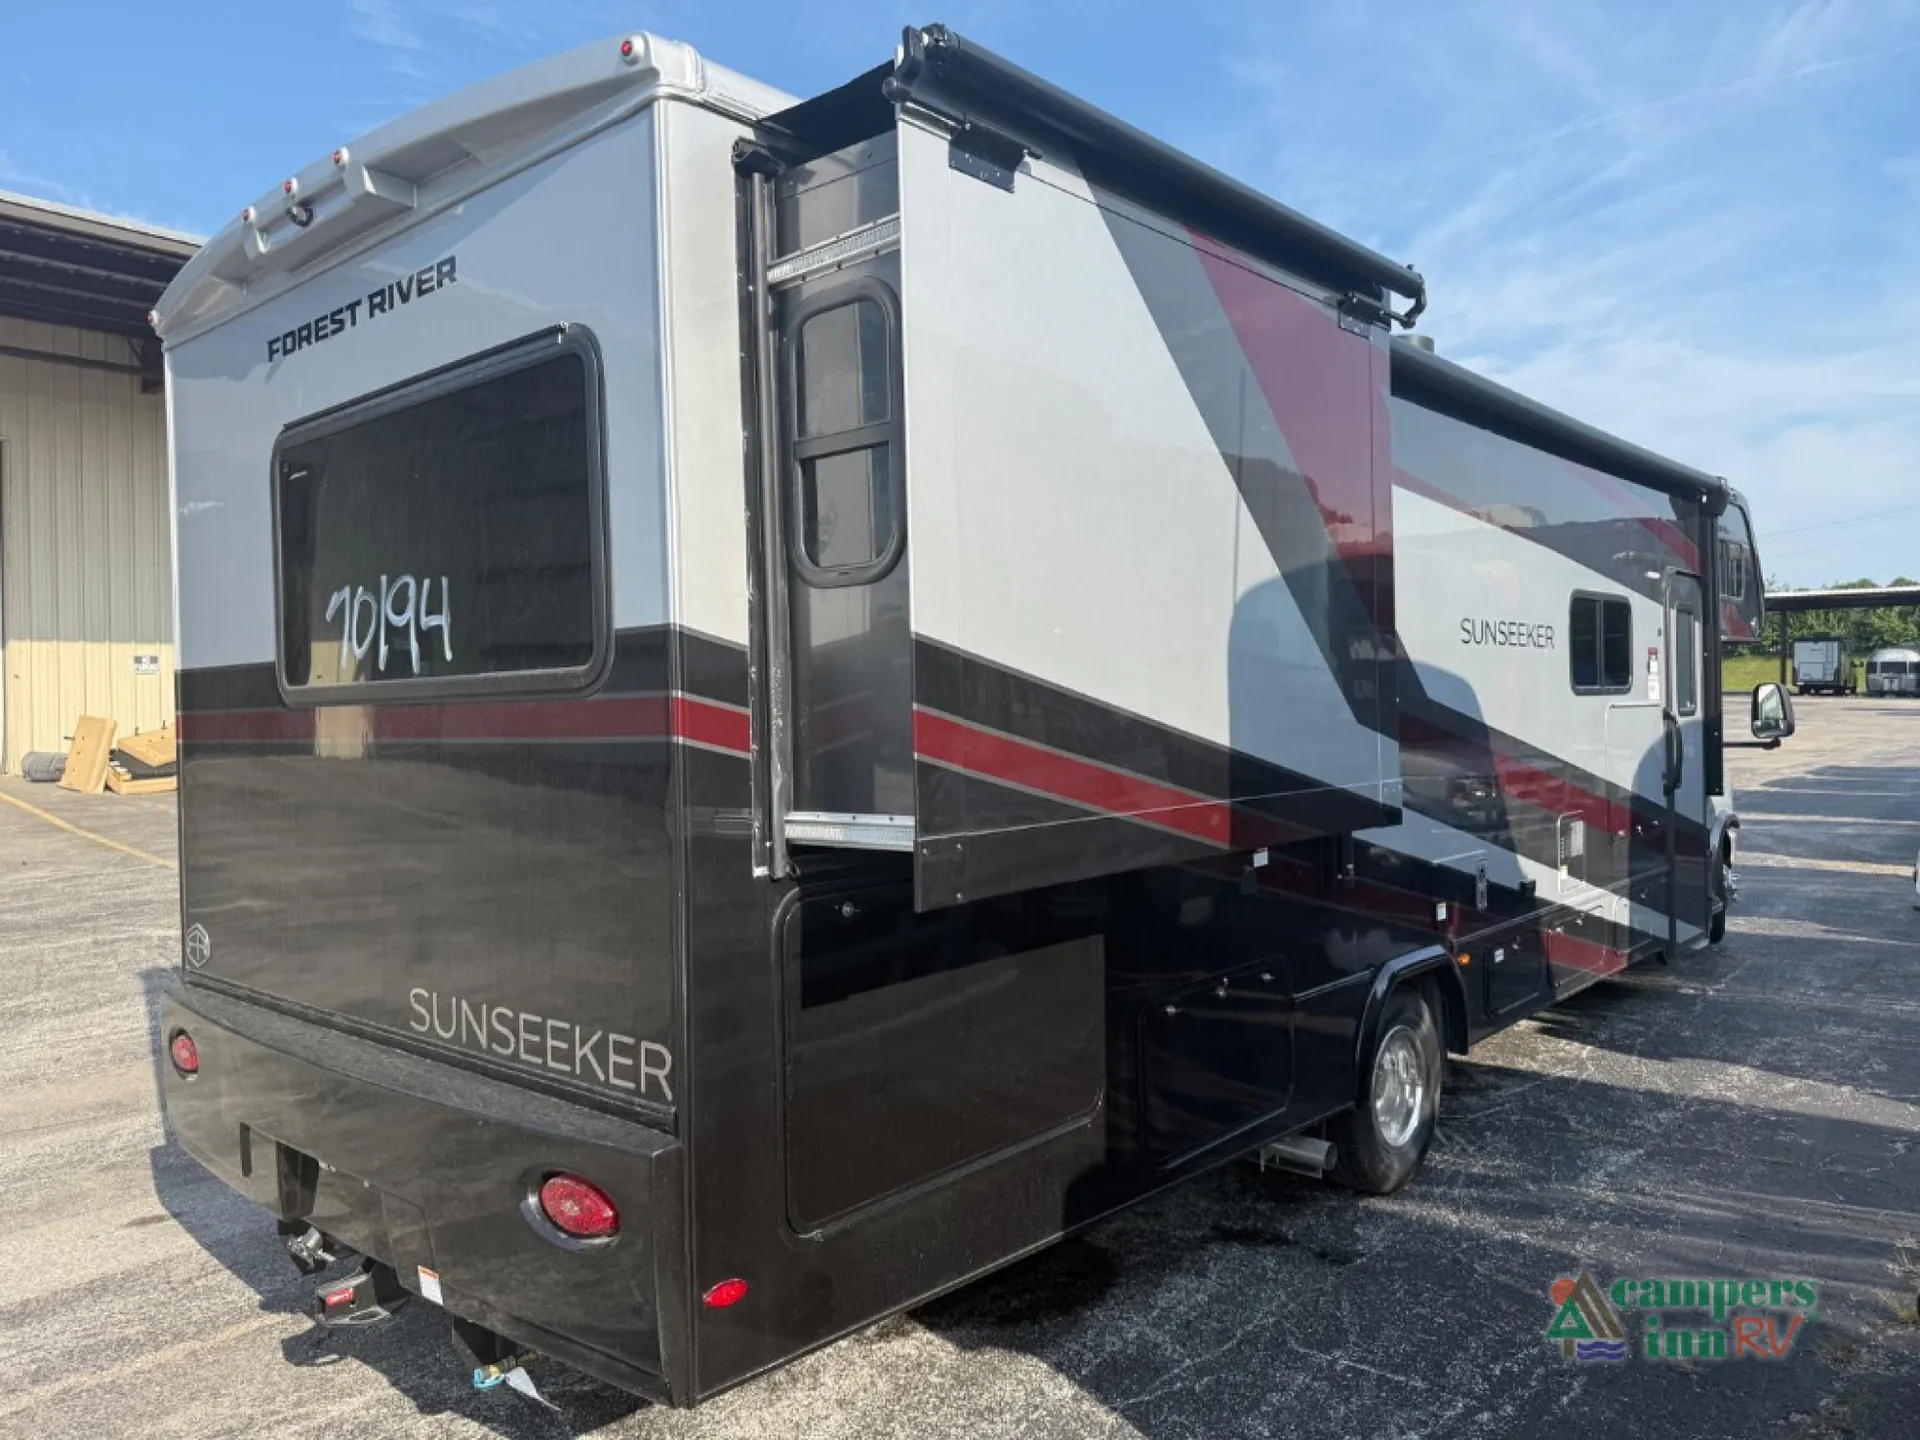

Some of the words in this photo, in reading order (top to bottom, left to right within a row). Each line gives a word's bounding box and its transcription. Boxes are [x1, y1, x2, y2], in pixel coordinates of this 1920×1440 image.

[267, 299, 362, 362] FOREST
[367, 255, 458, 320] RIVER
[326, 574, 453, 674] 70194
[1460, 618, 1555, 649] SUNSEEKER
[409, 987, 673, 1101] SUNSEEKER
